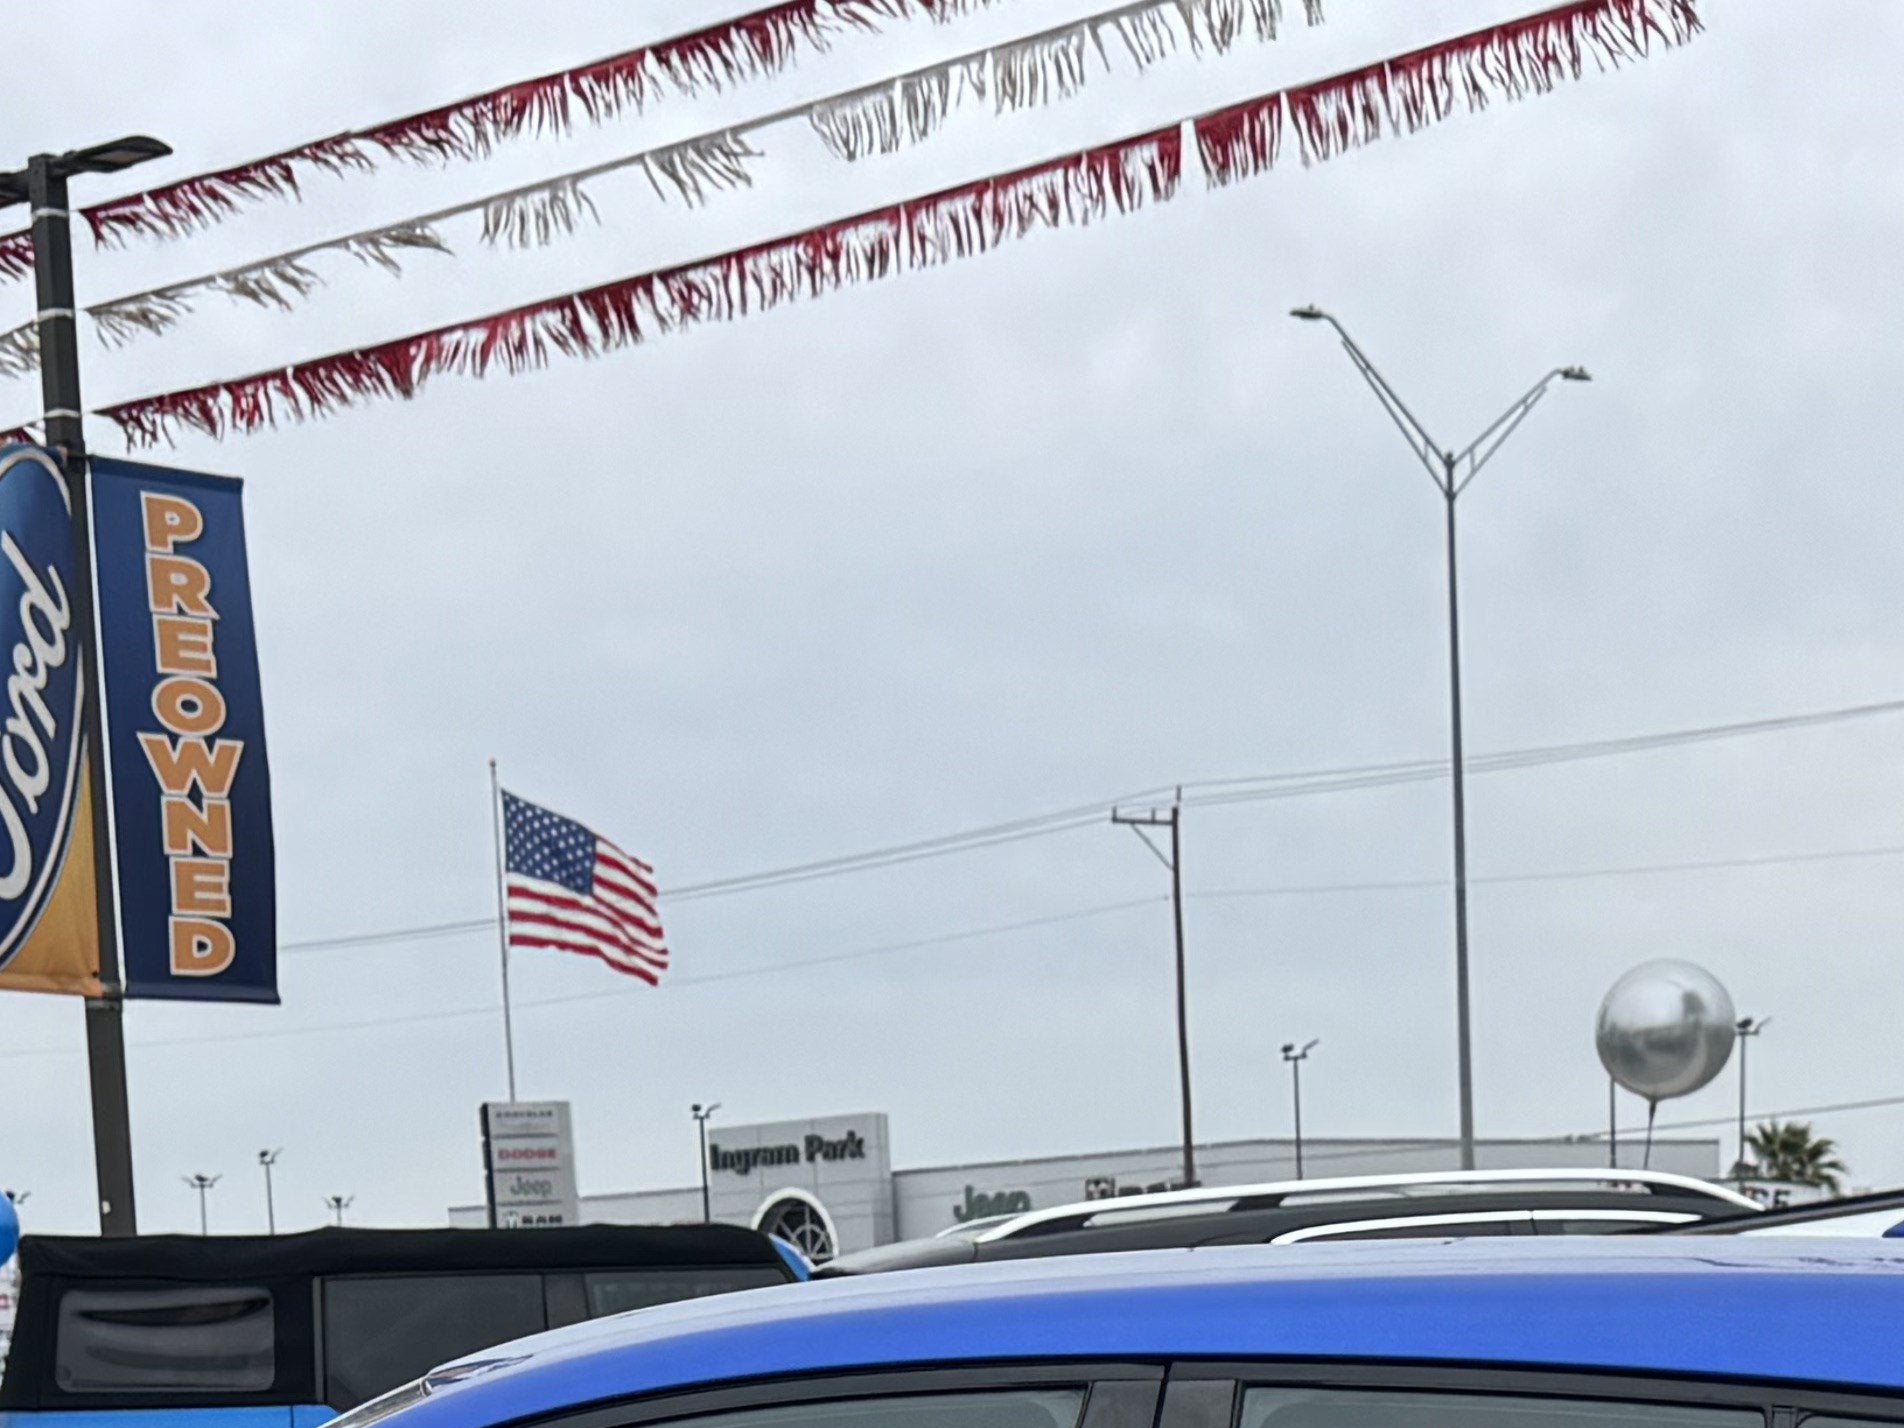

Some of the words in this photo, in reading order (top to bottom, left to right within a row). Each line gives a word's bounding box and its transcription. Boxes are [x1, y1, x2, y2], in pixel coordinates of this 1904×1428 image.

[137, 489, 244, 978] PREOWNED
[710, 1143, 800, 1175] Ingram
[804, 1130, 865, 1162] Park
